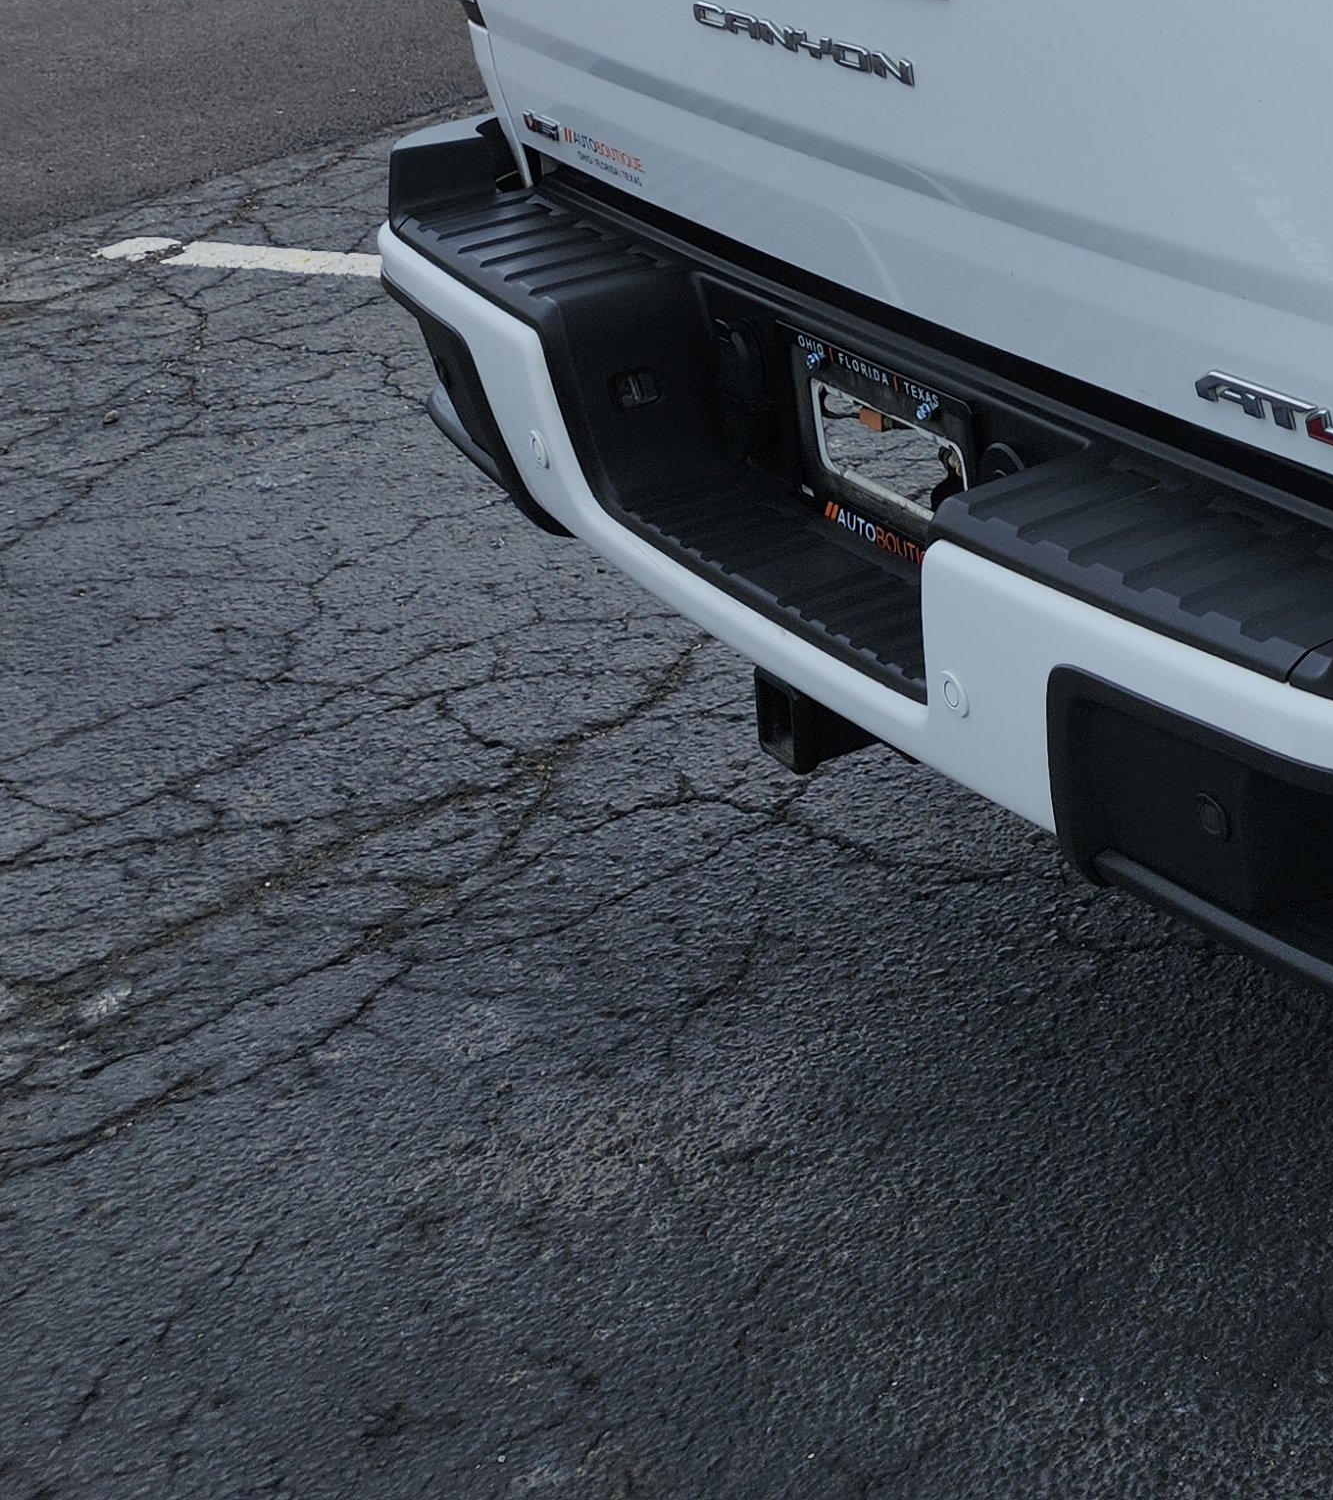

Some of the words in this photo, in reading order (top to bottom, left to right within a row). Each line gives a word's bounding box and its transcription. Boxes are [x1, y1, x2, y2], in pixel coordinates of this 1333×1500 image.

[692, 0, 915, 87] CANYON
[797, 334, 825, 357] OHIO
[837, 352, 890, 387] FLORIDA
[903, 381, 940, 409] TEXAS
[837, 507, 926, 566] AUTOBOUTI
